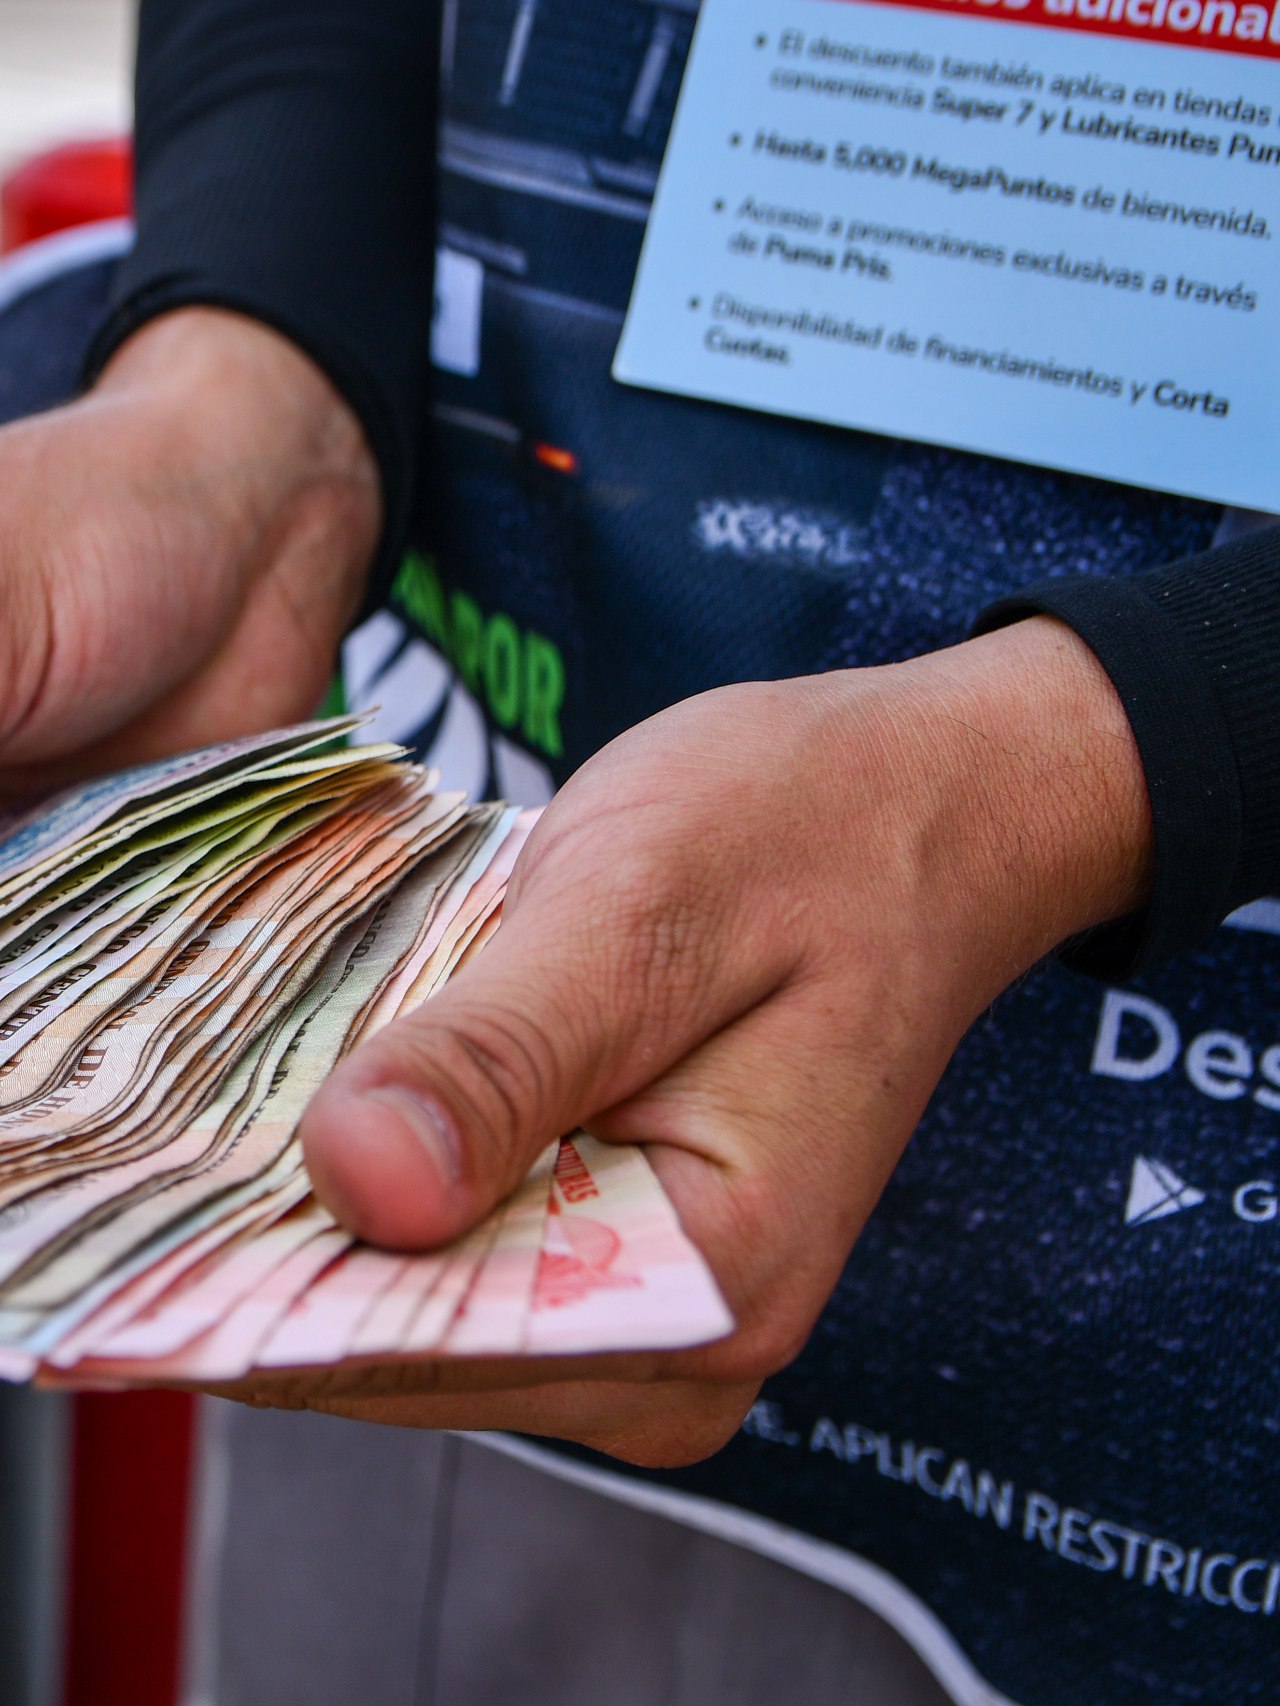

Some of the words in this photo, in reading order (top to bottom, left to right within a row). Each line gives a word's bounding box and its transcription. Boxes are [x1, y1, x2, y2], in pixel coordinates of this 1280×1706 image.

[770, 66, 925, 110] conveniencia
[931, 84, 1008, 123] Super
[1016, 99, 1036, 126] 7
[1040, 110, 1057, 136] y
[1061, 107, 1221, 156] Lubricantes
[778, 27, 804, 54] El
[808, 33, 935, 74] descuento
[940, 53, 1044, 93] también
[1050, 72, 1126, 105] aplica
[1133, 86, 1166, 110] en
[1173, 88, 1271, 127] tiendas
[753, 129, 826, 164] Hasta
[833, 141, 908, 178] 5,000
[910, 154, 1076, 205] MegaPuntos
[1082, 184, 1116, 213] de
[1122, 188, 1272, 241] bienvenida.
[728, 231, 759, 256] de
[764, 233, 836, 271] Puma
[737, 196, 822, 232] Acceso
[828, 216, 843, 236] a
[846, 218, 1006, 267] promociones
[1013, 248, 1144, 293] exclusivas
[1151, 274, 1168, 297] a
[1175, 273, 1258, 313] través
[712, 291, 884, 349] Disponibilidad
[886, 327, 919, 356] de
[923, 333, 1122, 398] financiamientos
[1130, 382, 1148, 407] y
[1153, 378, 1231, 419] Corta
[61, 1045, 110, 1091] DE
[809, 1415, 1014, 1530] APLICAN
